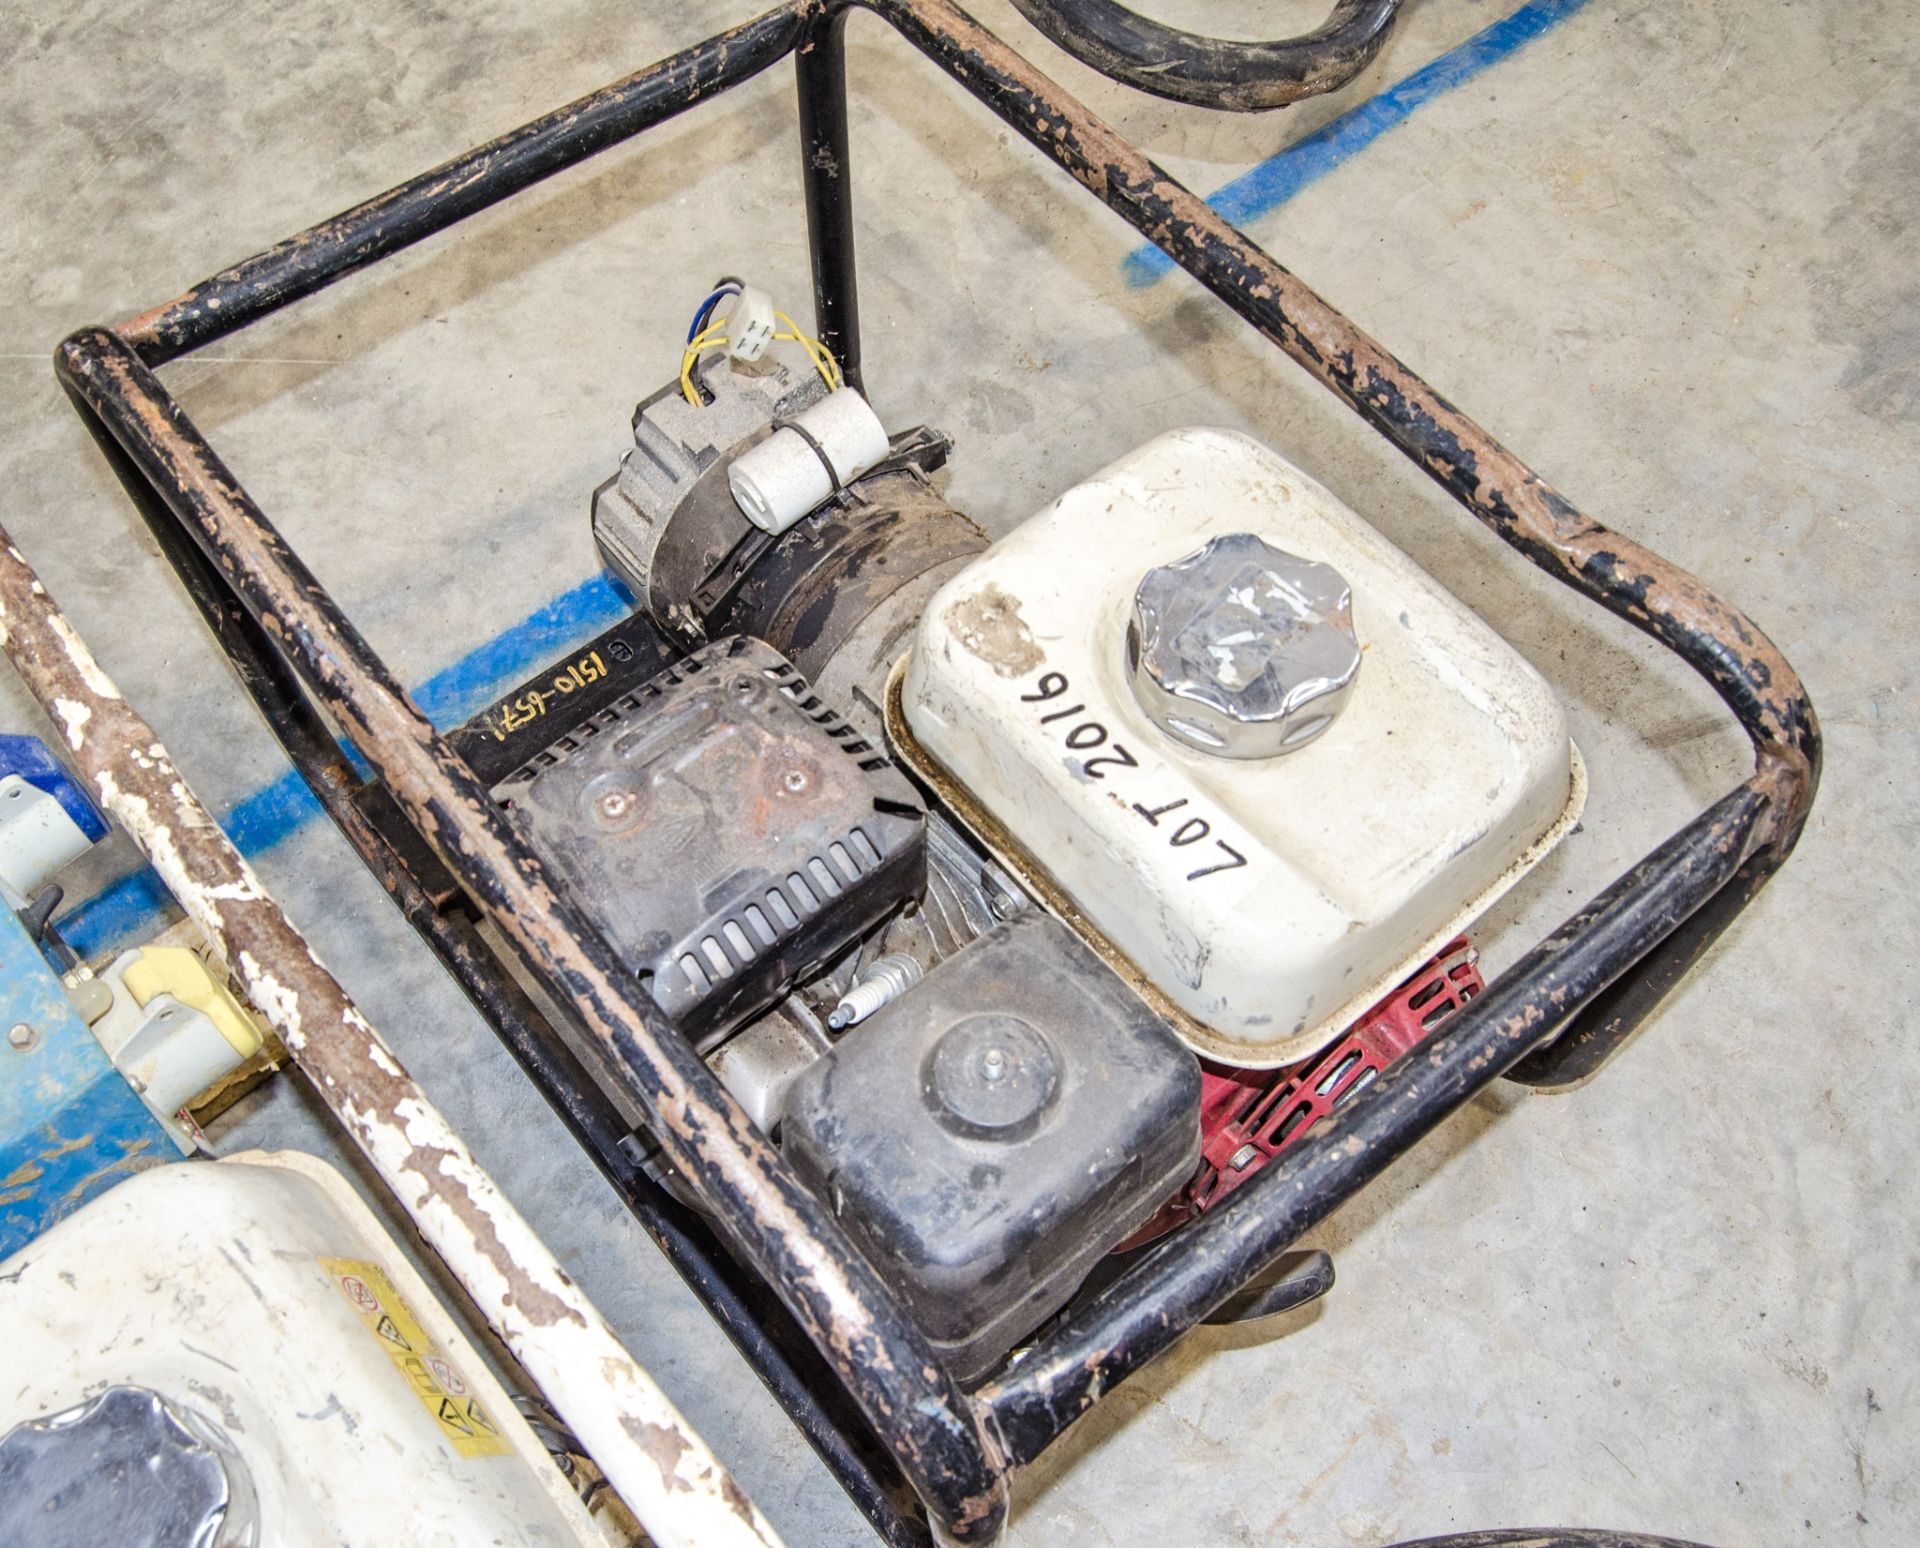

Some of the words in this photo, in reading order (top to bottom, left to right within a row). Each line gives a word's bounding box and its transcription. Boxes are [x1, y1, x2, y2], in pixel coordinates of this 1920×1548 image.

[483, 651, 607, 742] 1510-6571
[1020, 671, 1139, 780] 2016
[1132, 798, 1248, 882] LOT
